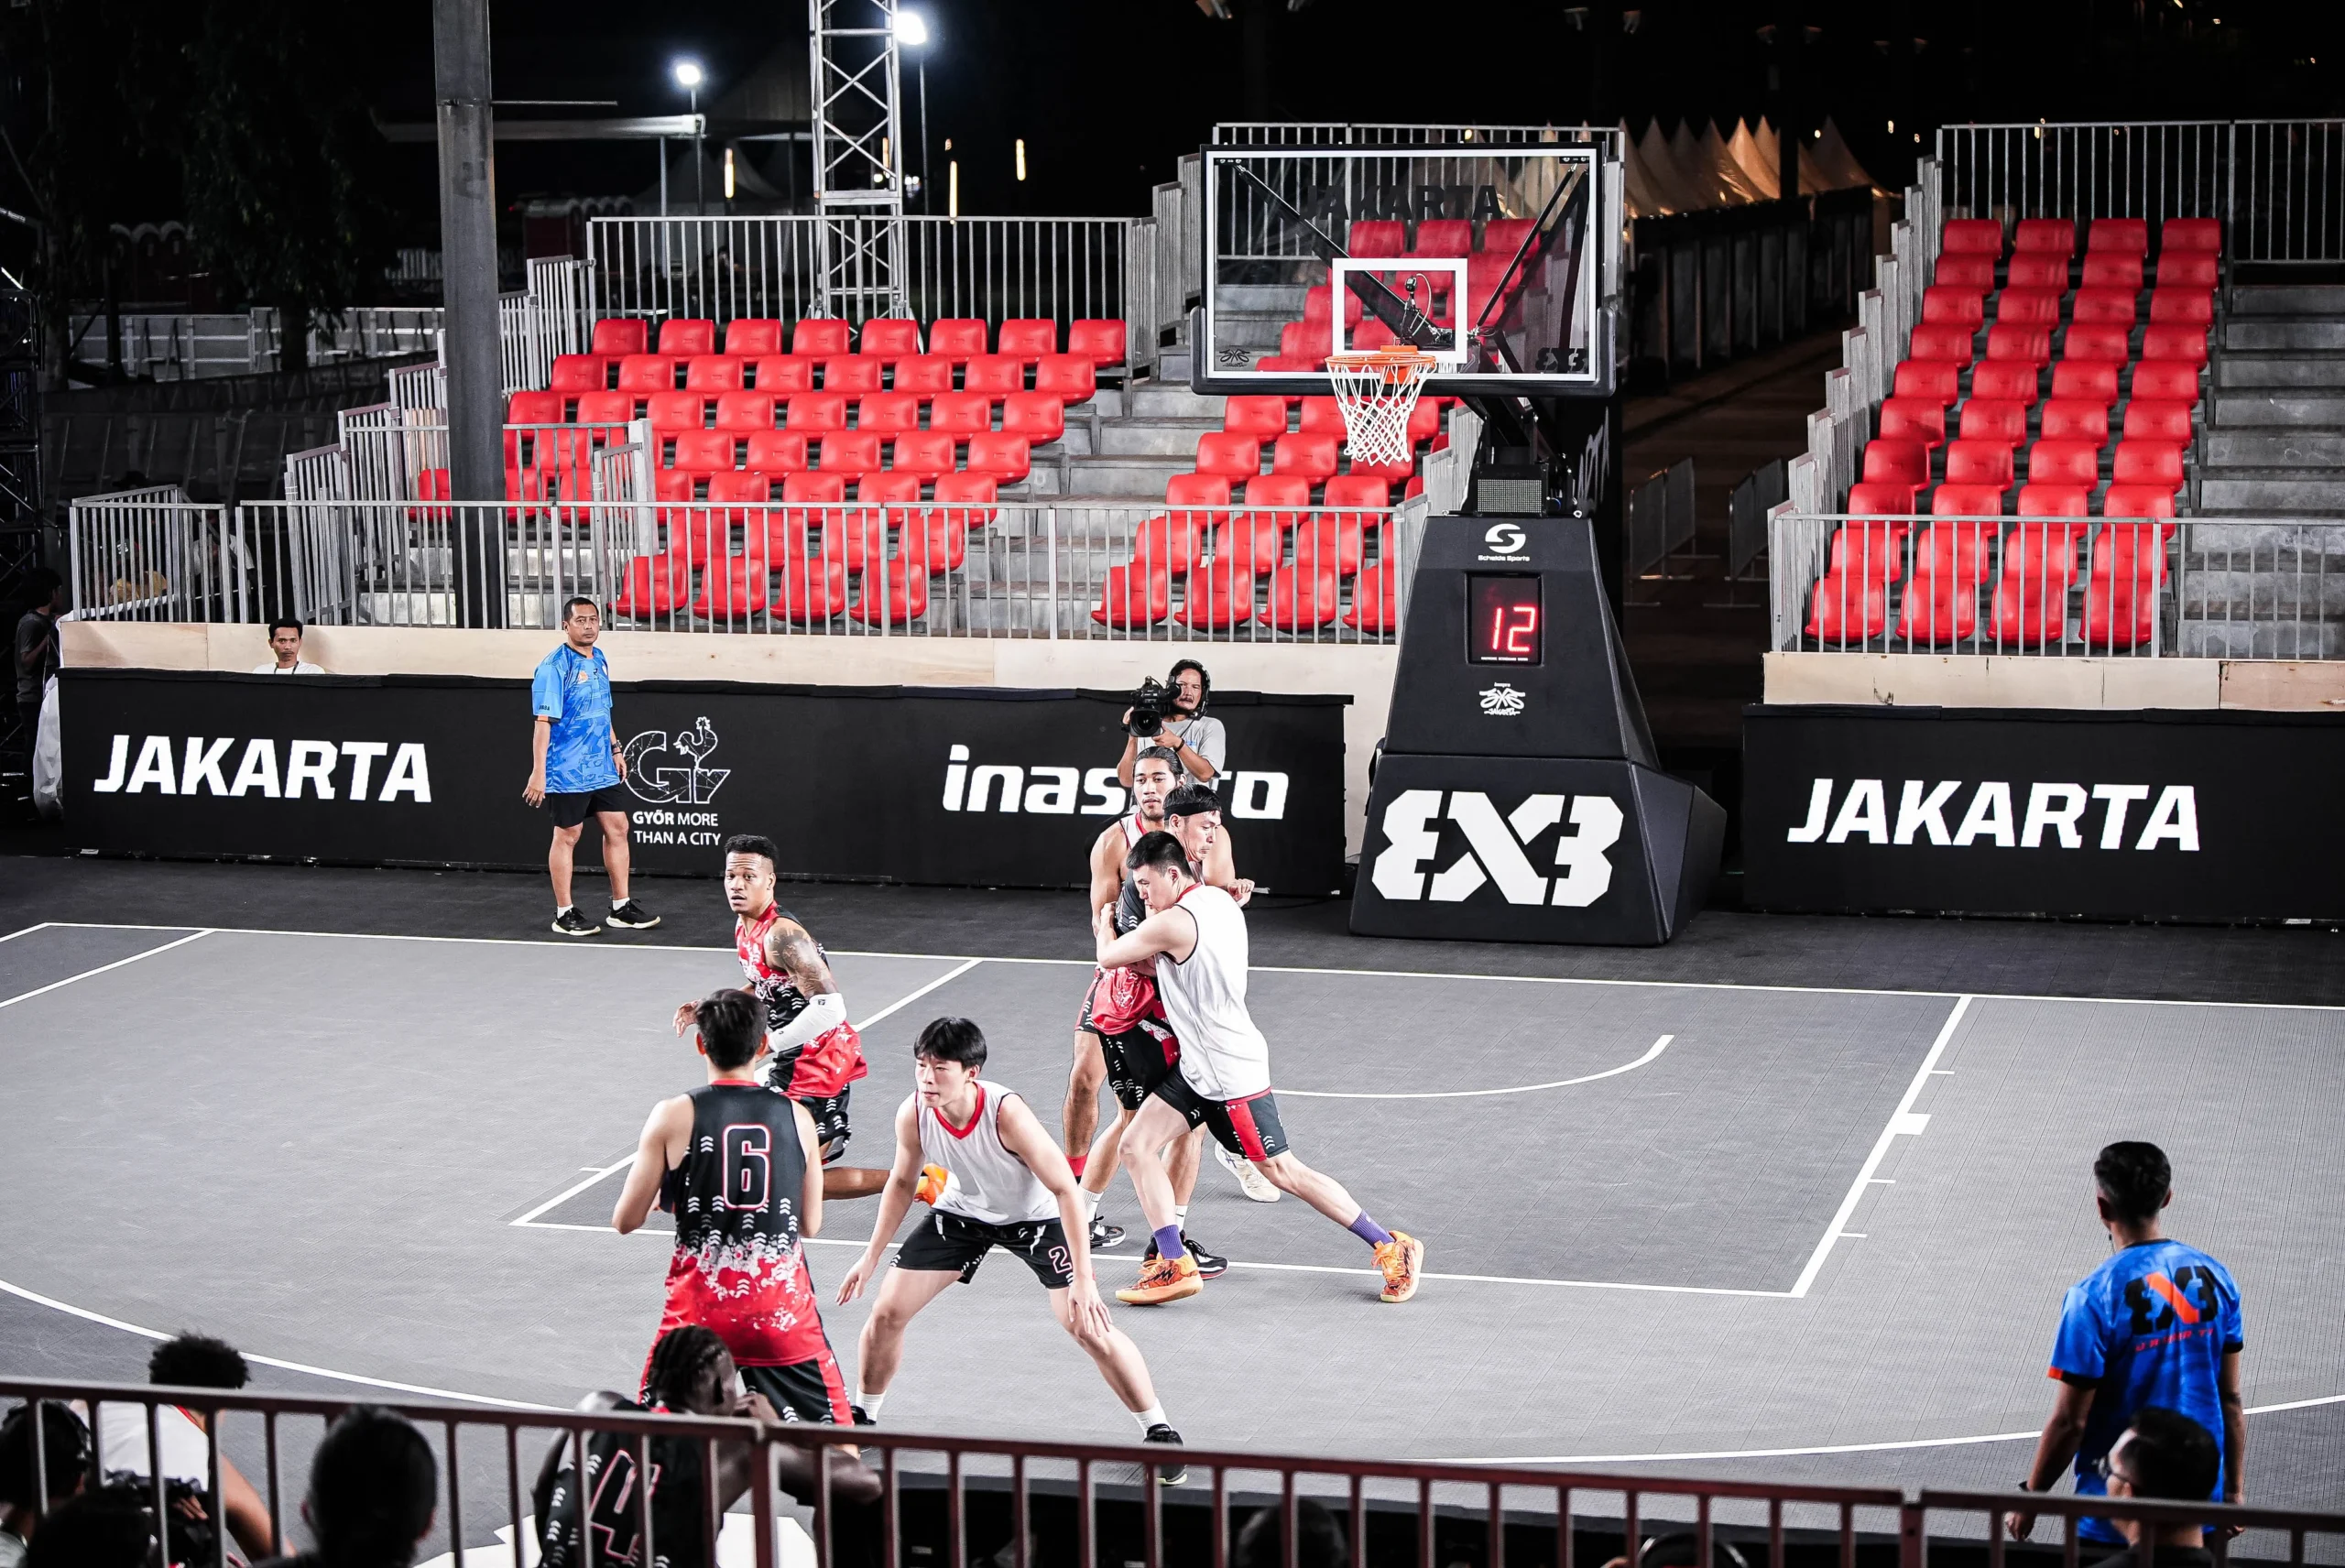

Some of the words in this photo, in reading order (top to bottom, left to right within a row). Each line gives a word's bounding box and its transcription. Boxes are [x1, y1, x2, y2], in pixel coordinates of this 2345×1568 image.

[1301, 185, 1503, 221] JAKARTA
[1491, 606, 1536, 653] 12
[93, 735, 431, 802] JAKARTA
[677, 812, 719, 827] MORE
[1787, 778, 2200, 851] JAKARTA
[634, 830, 674, 844] THAN
[677, 832, 688, 845] A
[690, 832, 722, 846] CITY
[722, 1123, 771, 1210] 6
[1048, 1246, 1073, 1274] 2
